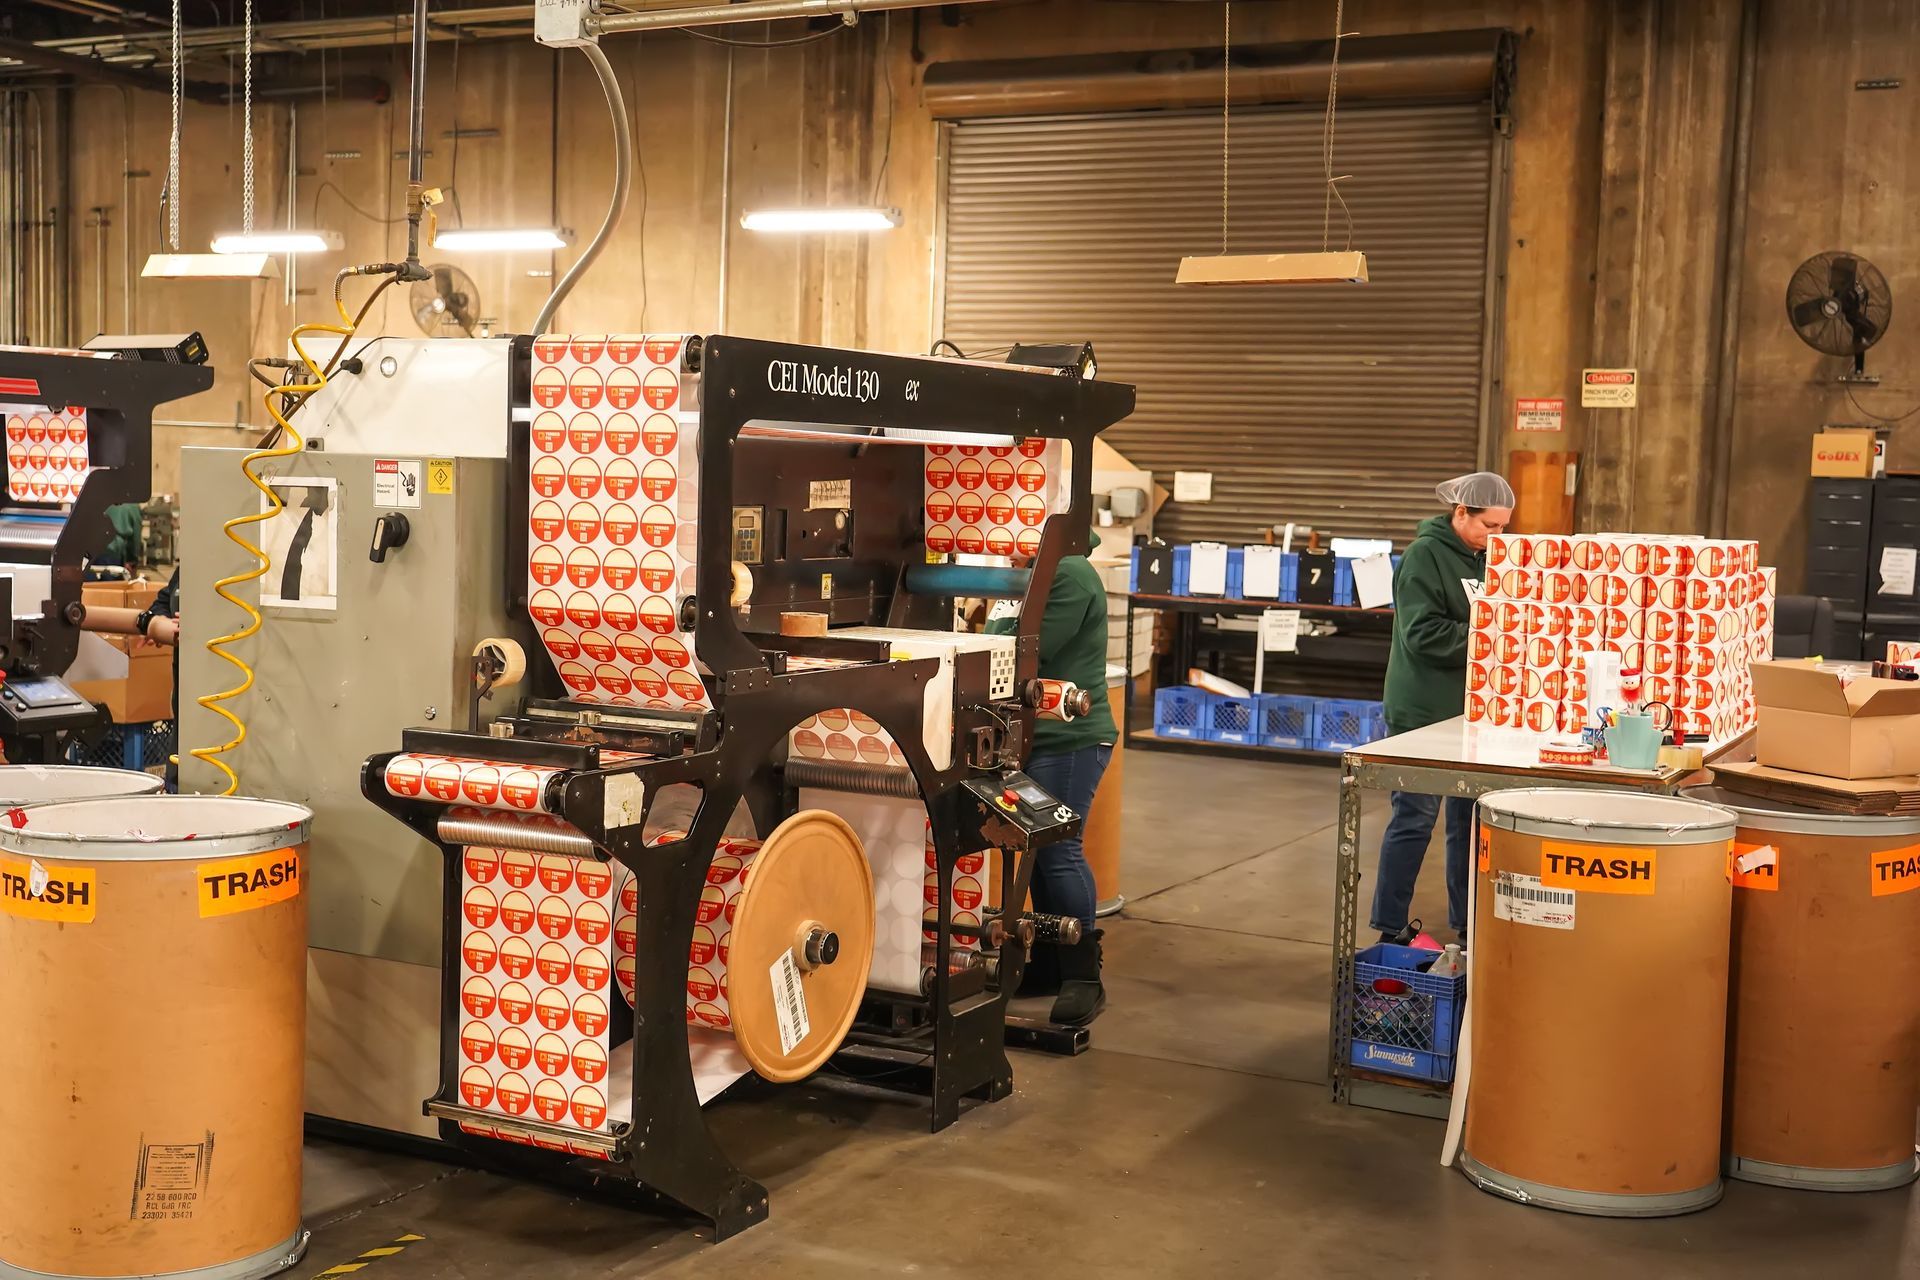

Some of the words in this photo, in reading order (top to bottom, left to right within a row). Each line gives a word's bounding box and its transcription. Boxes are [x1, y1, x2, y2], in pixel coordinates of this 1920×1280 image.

[768, 360, 798, 392] CEI
[801, 364, 852, 398] Model
[855, 370, 880, 402] 130
[905, 378, 920, 402] ex
[1592, 374, 1627, 382] DANGER
[1150, 558, 1160, 575] 4
[1310, 568, 1322, 585] 7
[204, 857, 297, 899] TRASH
[1546, 854, 1652, 881] TRASH
[1365, 1044, 1416, 1065] Sunnyside
